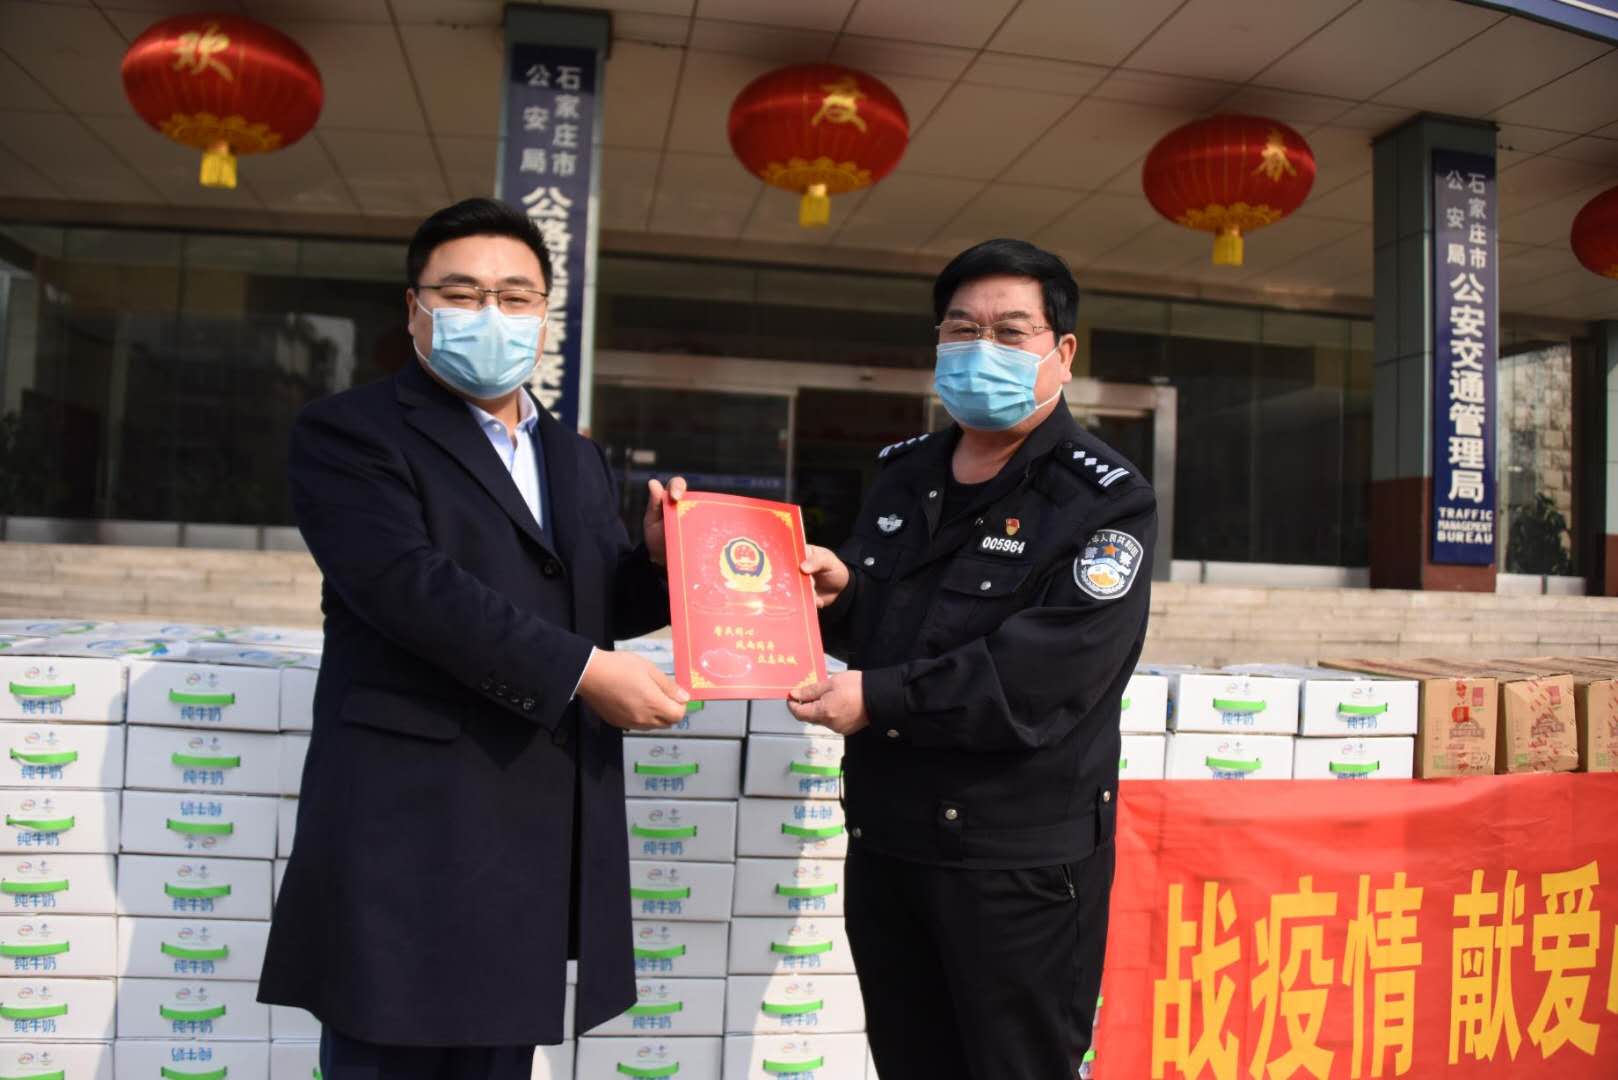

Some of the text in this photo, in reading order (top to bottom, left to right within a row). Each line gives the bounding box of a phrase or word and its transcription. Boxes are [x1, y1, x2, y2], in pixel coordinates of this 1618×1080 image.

[520, 64, 551, 175] 公安局
[552, 65, 582, 177] 石家庄市
[1446, 169, 1466, 267] 公安局
[1468, 172, 1488, 269] 石家庄市
[1449, 272, 1486, 504] 公安交通管理局
[1439, 506, 1493, 521] TRAFFIC
[1437, 519, 1493, 533] MANAGEMENT
[982, 536, 1025, 554] 005964
[1436, 530, 1493, 545] BUREAU
[14, 894, 56, 908] 纯牛奶
[14, 956, 56, 971] 纯牛奶
[1150, 871, 1424, 1080] 战疫情
[14, 1019, 56, 1034] 纯牛奶
